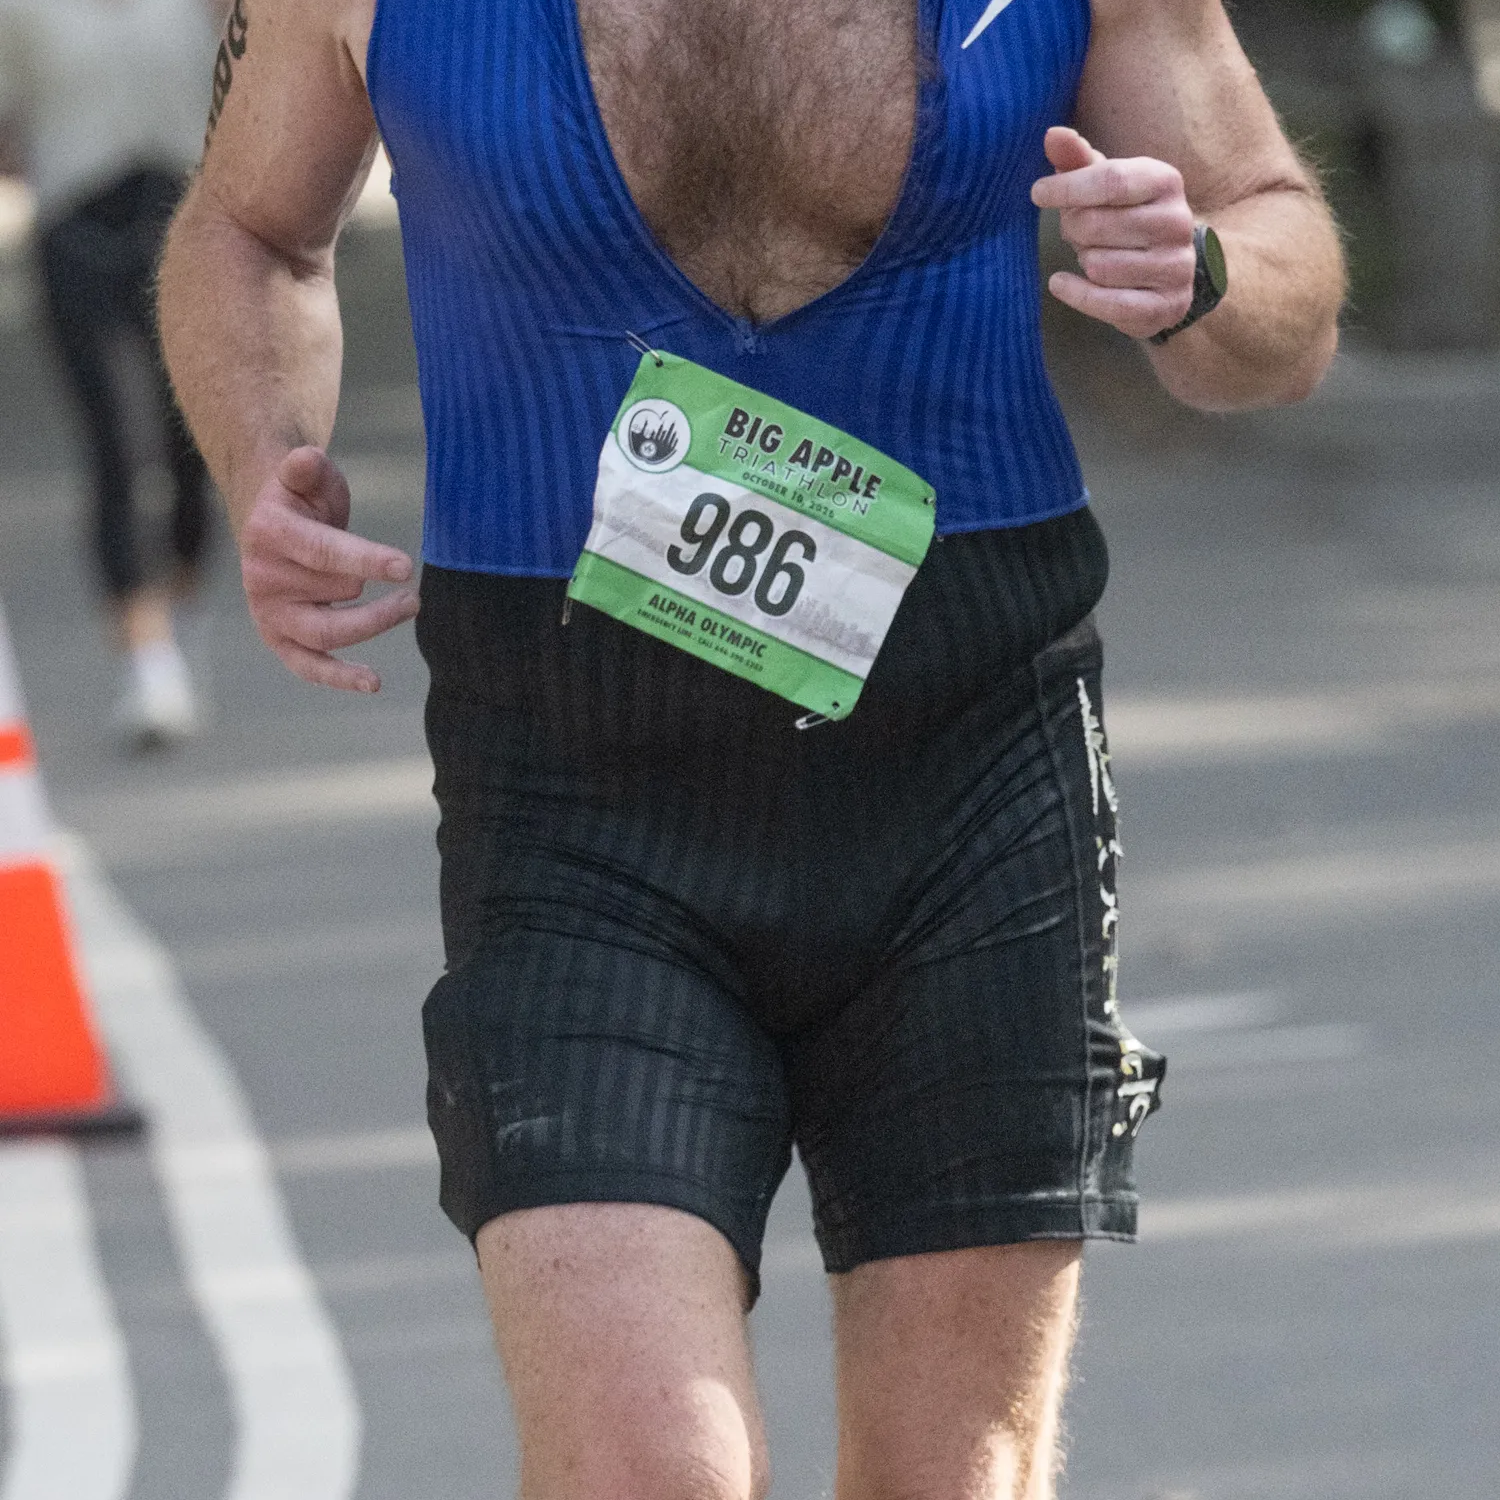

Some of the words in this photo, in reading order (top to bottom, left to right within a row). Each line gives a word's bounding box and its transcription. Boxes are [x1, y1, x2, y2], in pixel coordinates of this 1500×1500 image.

[719, 437, 869, 516] TRIATHLON
[724, 407, 784, 453] BIG
[788, 439, 882, 499] APPLE
[742, 472, 789, 497] OCTOBER
[667, 492, 817, 617] 986
[648, 594, 697, 626] ALPHA
[700, 617, 767, 658] OLYMPIC
